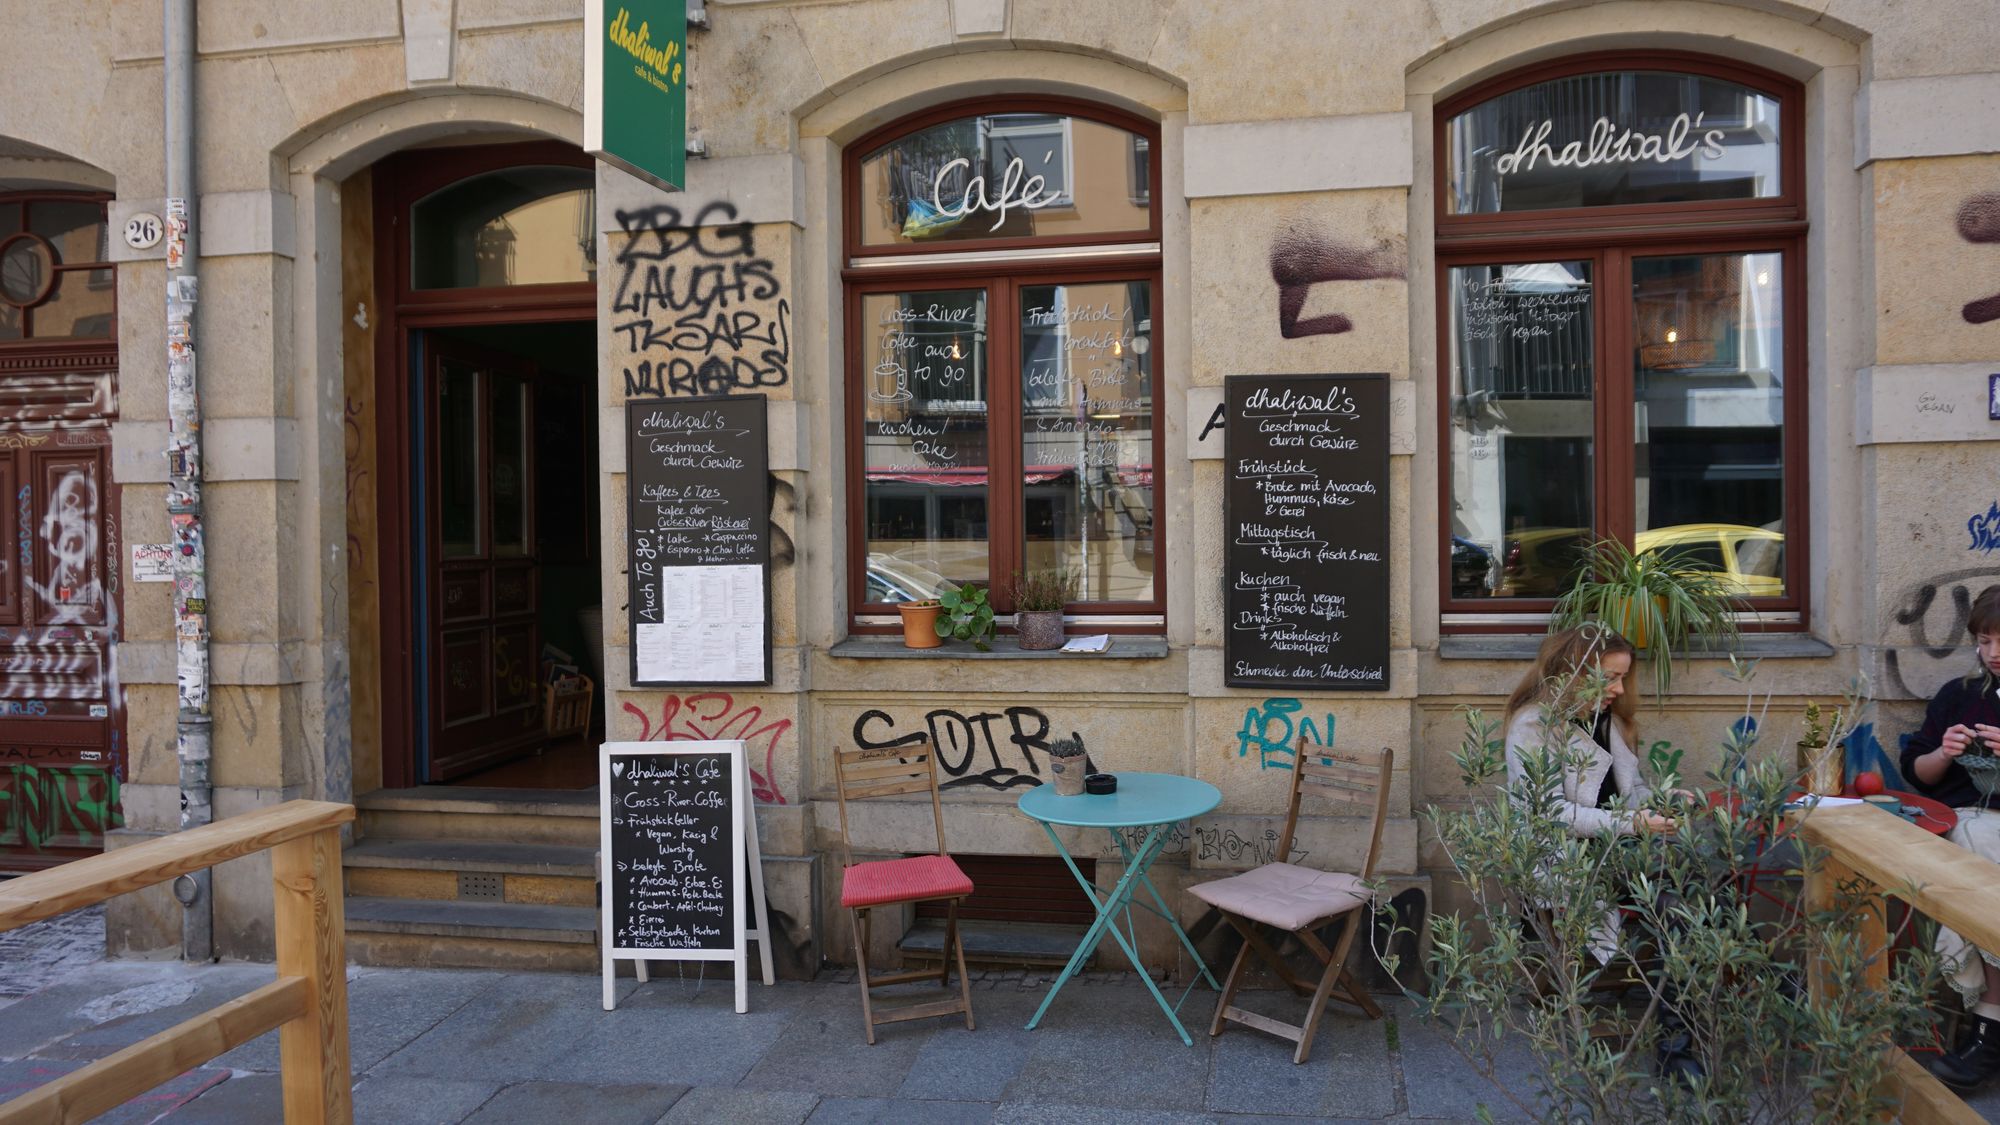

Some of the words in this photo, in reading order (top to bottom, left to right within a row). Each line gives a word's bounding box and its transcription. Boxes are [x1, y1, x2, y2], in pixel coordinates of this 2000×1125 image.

[610, 7, 682, 84] dhaliwal's
[1497, 111, 1728, 174] dhaliwal's
[934, 150, 1061, 233] Café
[129, 220, 155, 243] 26
[882, 329, 918, 354] Coffee
[1513, 326, 1552, 344] vegan
[925, 345, 969, 360] auch
[914, 362, 931, 380] to
[940, 366, 965, 386] go
[1246, 386, 1356, 412] dhaliwal's
[642, 410, 725, 430] dhaliwal's
[1260, 419, 1341, 432] Geschmack
[650, 438, 726, 454] Geschmack
[912, 439, 958, 460] Cake
[1270, 434, 1304, 446] durch
[1310, 435, 1358, 450] Gewürz
[663, 455, 700, 468] durch
[1240, 458, 1317, 474] Frühstück
[643, 484, 679, 500] Kaffees
[684, 486, 692, 498] &
[695, 485, 720, 498] Tees
[1265, 481, 1296, 492] Brote
[1300, 480, 1321, 492] mit
[1325, 480, 1376, 494] Avocado,
[1323, 494, 1356, 506] Käse
[690, 504, 712, 514] der
[1266, 504, 1276, 516] &
[711, 532, 758, 544] Cappuccino
[1240, 523, 1316, 544] Mittagstisch
[636, 529, 657, 559] go!
[712, 546, 732, 554] Chai
[736, 543, 756, 554] Latte
[135, 550, 173, 560] ACHTUN
[1271, 546, 1311, 562] täglich
[1316, 550, 1347, 563] frisch
[1349, 550, 1358, 560] &
[1359, 552, 1382, 562] neu
[636, 562, 654, 581] To
[1240, 571, 1290, 586] Kuchen
[640, 583, 658, 620] Auch
[1274, 590, 1306, 602] auch
[1314, 593, 1345, 605] vegan
[1240, 611, 1282, 624] Drinks
[1272, 601, 1308, 616] frische
[1310, 604, 1349, 621] Waffeln
[1270, 630, 1330, 643] Alkoholisch
[1333, 632, 1342, 642] &
[1270, 641, 1329, 656] Alkoholfrei
[1234, 660, 1289, 677] Schmecke
[1292, 666, 1317, 678] den
[1320, 664, 1383, 681] Unterschied
[673, 860, 707, 874] Brote
[693, 924, 720, 936] Kuchen
[635, 938, 665, 948] Frische
[669, 936, 701, 948] Waffeln
